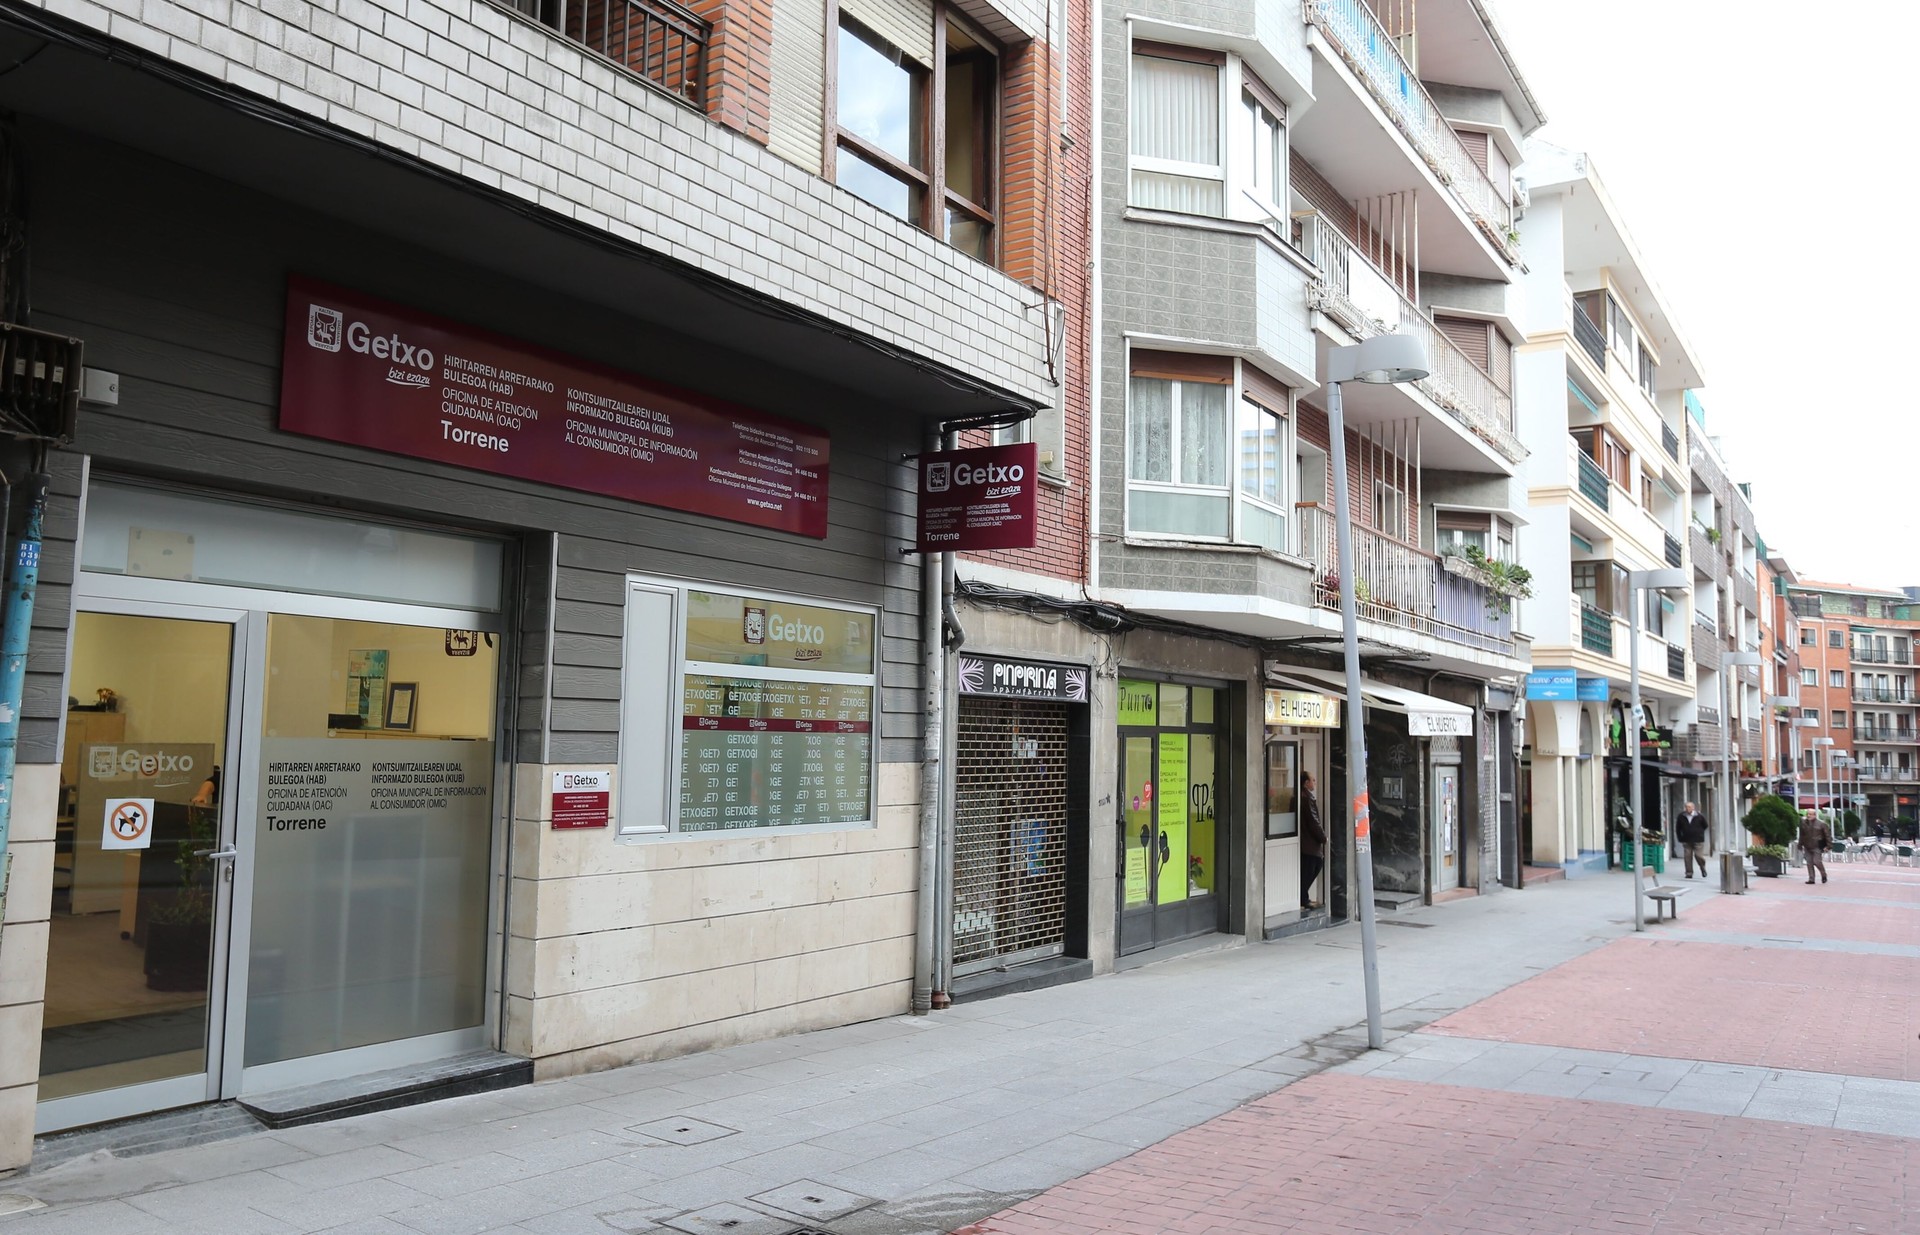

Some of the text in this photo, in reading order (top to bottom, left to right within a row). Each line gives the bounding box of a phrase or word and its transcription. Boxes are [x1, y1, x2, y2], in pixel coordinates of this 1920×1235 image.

[347, 322, 434, 370] Getxo
[389, 367, 430, 384] bizi ezazu
[444, 355, 554, 393] HIRITARREN ARRETARAKO
[444, 369, 513, 396] BULEGOA (HAB)
[443, 387, 538, 420] OFICINA DE ATENCIÓN
[567, 388, 670, 424] KONTSUMITZAILEAREN UDAL
[442, 401, 520, 431] CIUDADANA (OAC)
[567, 401, 673, 438] INFORMAZIO BULEGOA (KIUB)
[441, 420, 508, 452] Torrene
[566, 419, 697, 460] OFICINA MUNICIPAL DE INFORMACIÓN
[565, 432, 654, 463] AL CONSUMIDOR (OMIC)
[954, 463, 1024, 485] Getxo
[986, 487, 1000, 496] bizi
[926, 533, 959, 541] Torrene
[769, 614, 824, 644] Getxo
[993, 663, 1056, 689] PINPIRINA
[1281, 700, 1321, 718] EL HUERTO
[1427, 717, 1457, 732] EL HUERTO
[121, 750, 193, 772] Getxo
[269, 762, 361, 772] HIRITARREN ARRETARAKO
[372, 763, 462, 772] KONTSUMITZAILEAREN UDAL
[269, 775, 326, 785] BULEGOA (HAB)
[372, 774, 465, 784] INFORMAZIO BULEGOA (KIUB)
[574, 775, 598, 785] Getxo
[268, 786, 347, 799] OFICINA DE ATENCIÓN
[371, 785, 487, 797] OFICINA MUNICIPAL DE INFORMACIÓN
[267, 800, 333, 811] CIUDADANA (OAC)
[371, 799, 447, 809] AL CONSUMIDOR (OMIC)
[267, 816, 326, 831] Torrene
